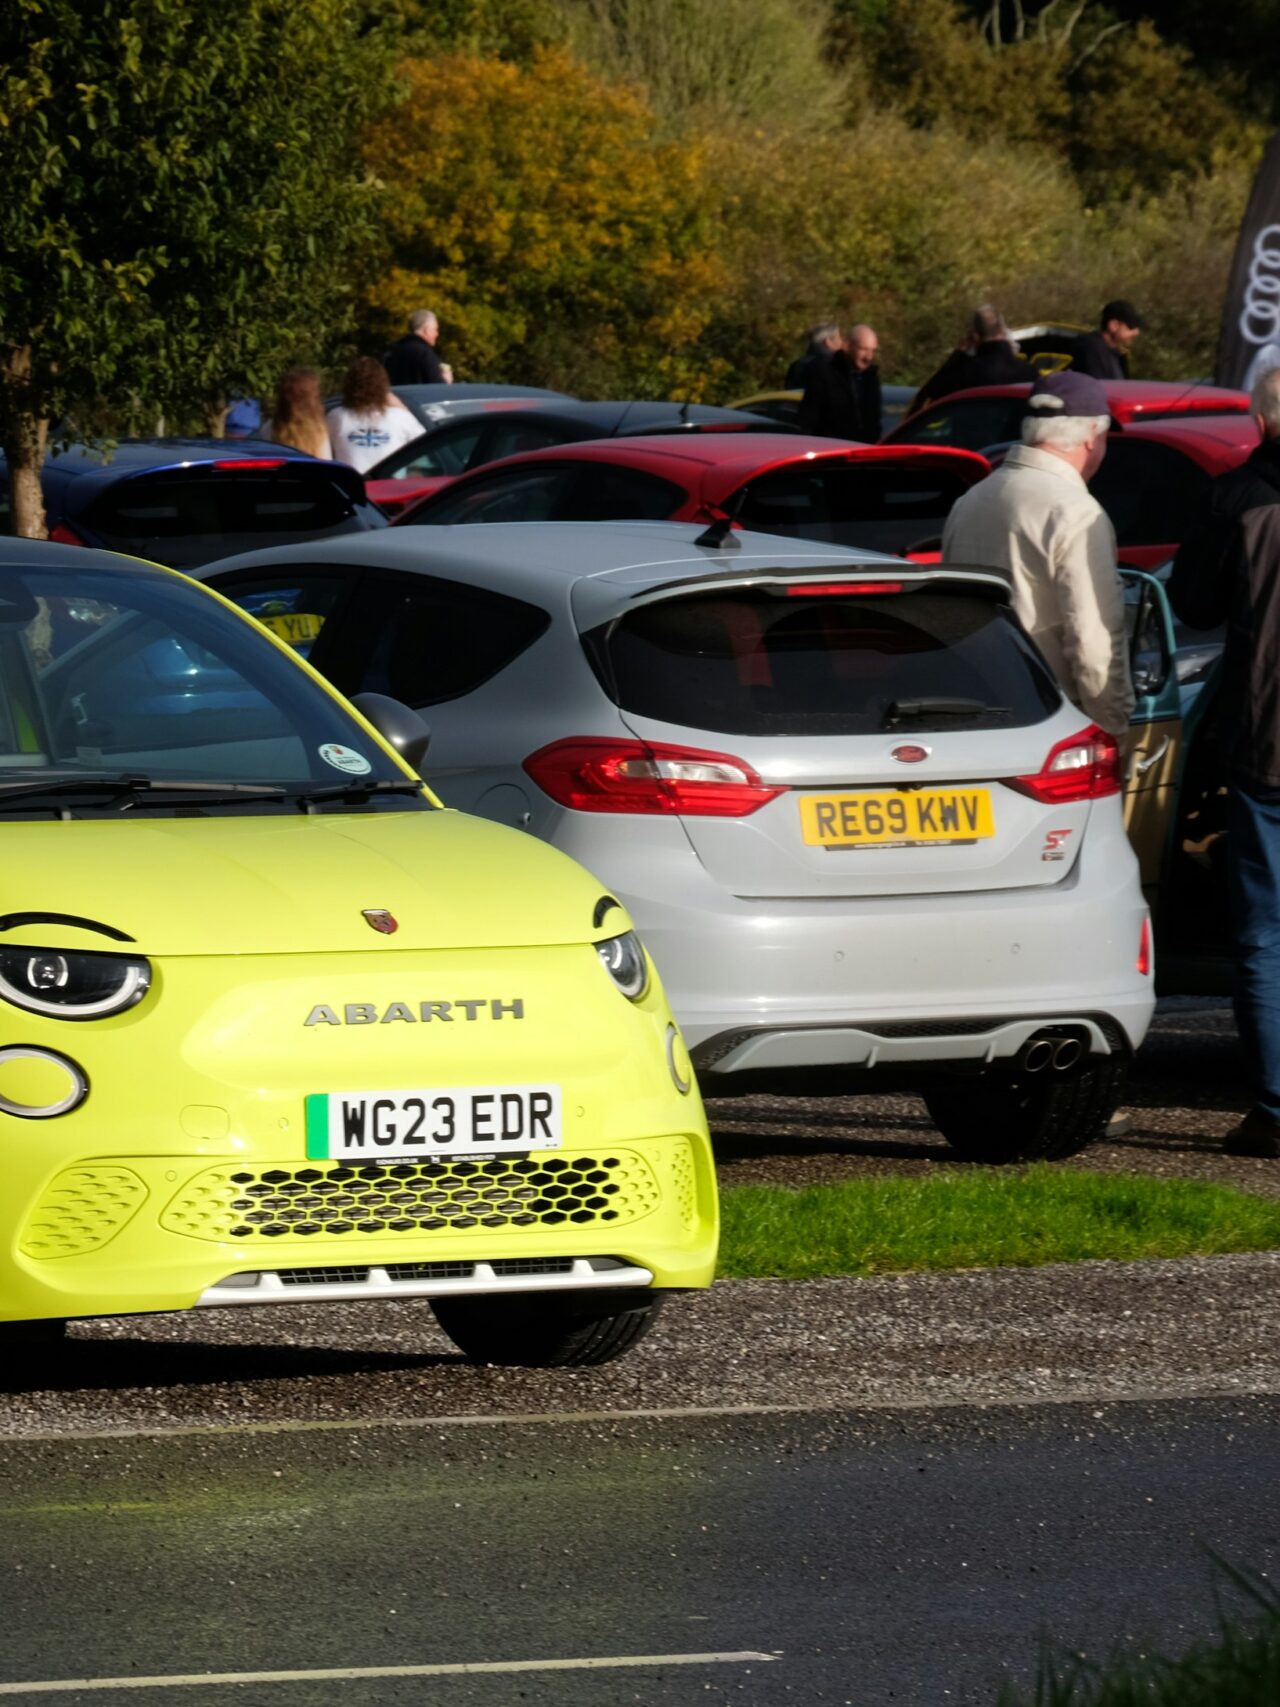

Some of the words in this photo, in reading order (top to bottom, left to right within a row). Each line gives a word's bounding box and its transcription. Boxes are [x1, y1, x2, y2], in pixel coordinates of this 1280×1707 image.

[816, 798, 907, 838] RE69
[916, 795, 978, 833] KWV
[303, 998, 524, 1026] ABARTH
[342, 1096, 455, 1147] WG23
[471, 1091, 553, 1142] EDR
